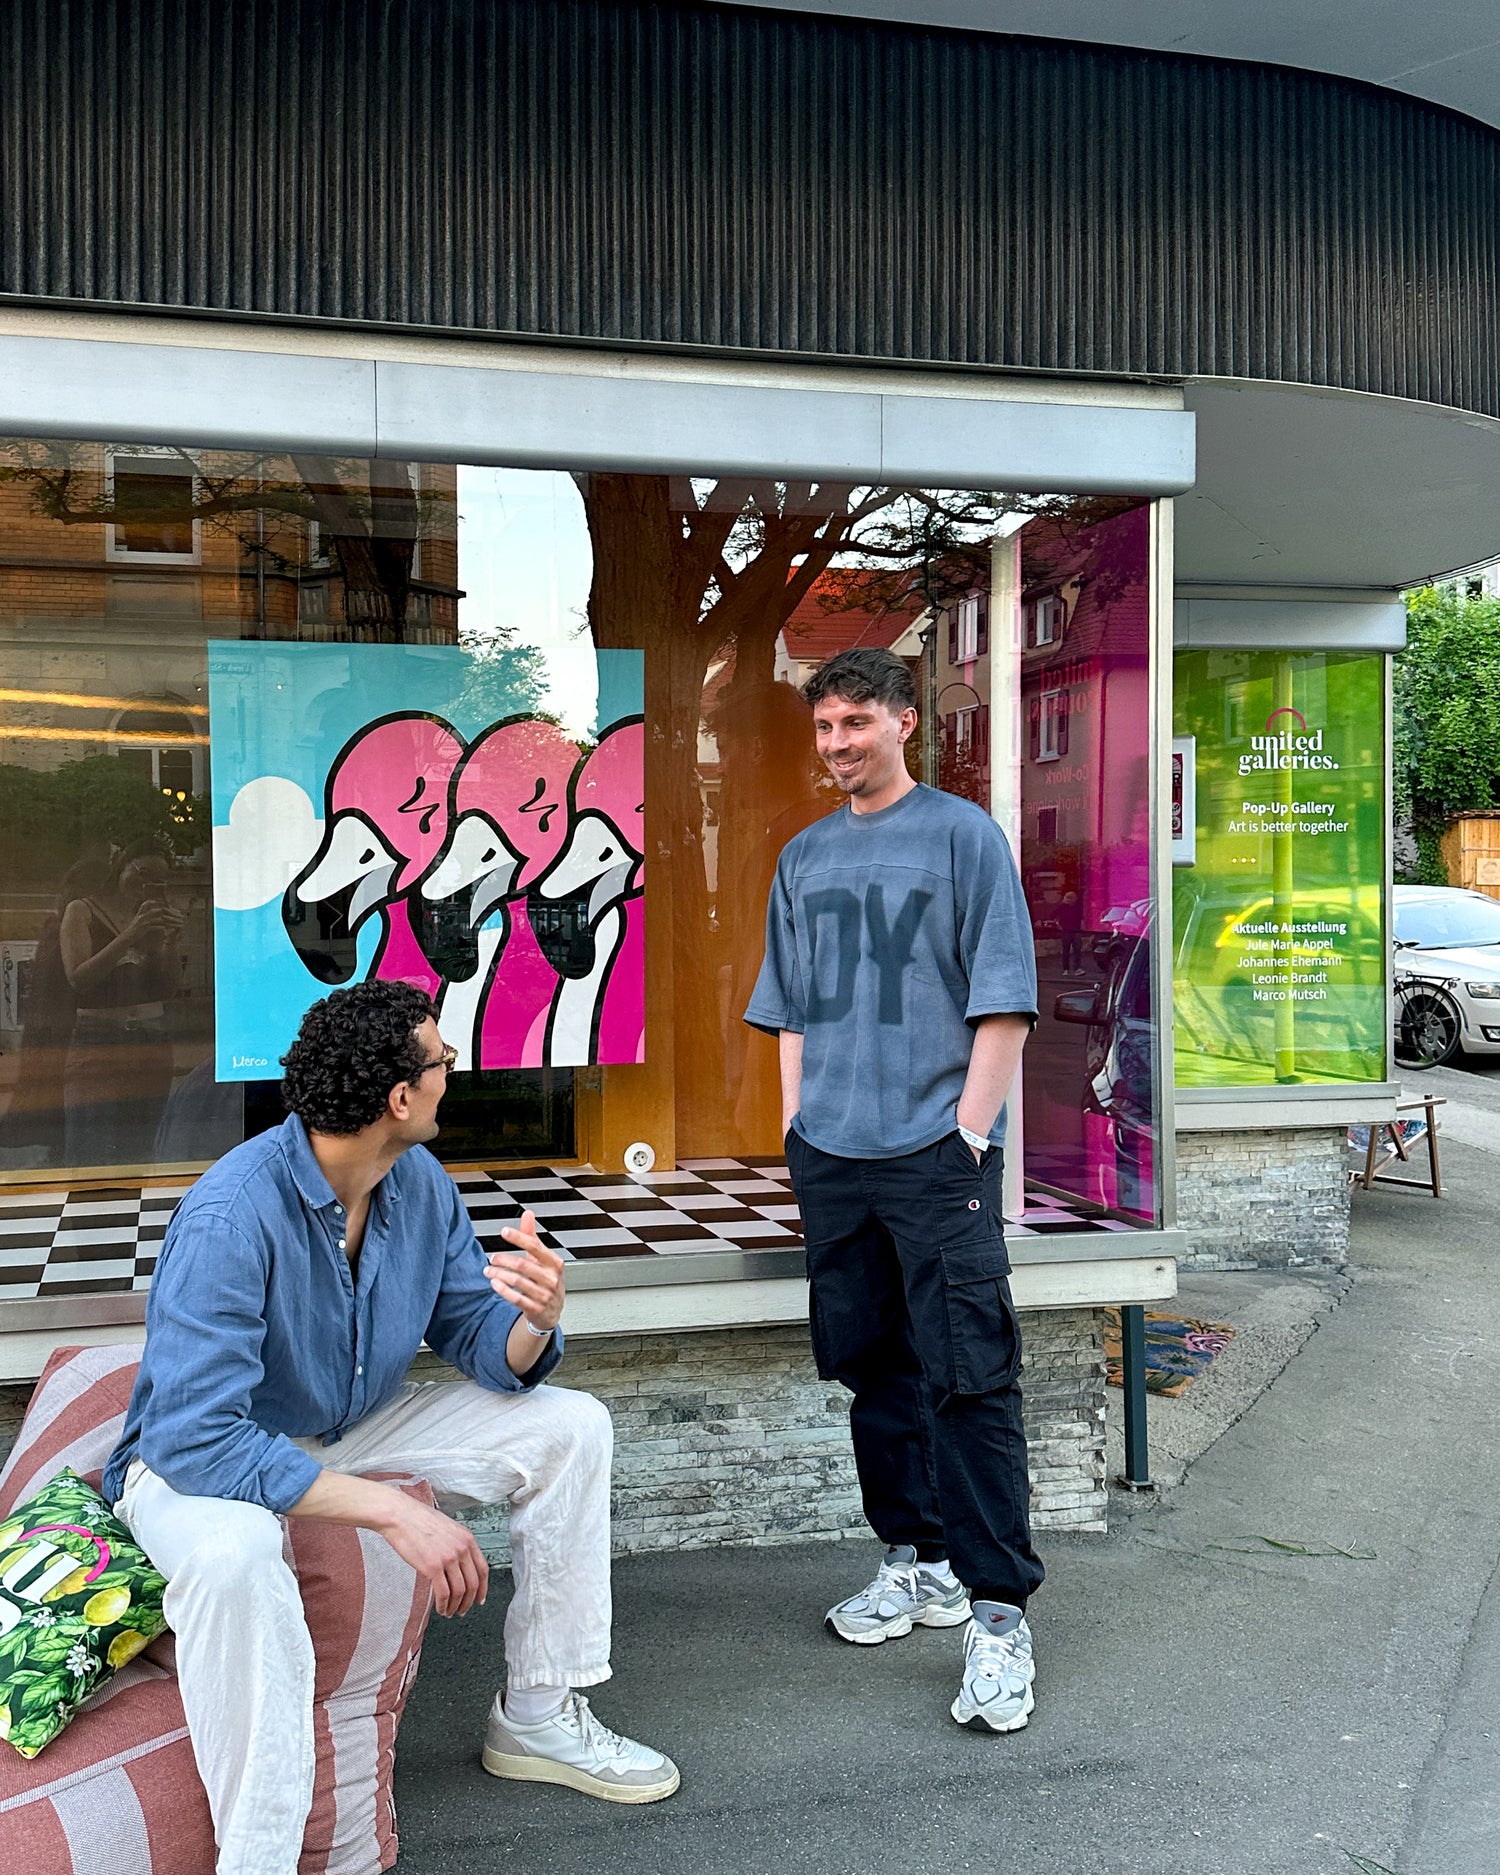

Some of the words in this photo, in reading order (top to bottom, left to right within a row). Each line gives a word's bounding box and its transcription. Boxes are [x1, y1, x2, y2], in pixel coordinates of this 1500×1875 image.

[1250, 729, 1323, 751] united
[1238, 749, 1340, 776] galleries.
[1242, 801, 1288, 817] Pop-Up
[1290, 801, 1335, 817] Gallery
[1228, 820, 1247, 833] Art
[1249, 820, 1259, 833] is
[1261, 819, 1297, 833] better
[1299, 819, 1349, 836] together
[1232, 921, 1279, 934] Aktuelle
[1280, 921, 1347, 935] Ausstellung
[1245, 939, 1269, 951] Jule
[1270, 939, 1300, 951] Marie
[1302, 937, 1334, 952] Appel
[1237, 956, 1290, 968] Johannes
[1291, 955, 1342, 967] Ehemann
[1252, 972, 1289, 985] Leonie
[1290, 971, 1328, 984] Brandt
[1252, 988, 1286, 1001] Marco
[1288, 987, 1327, 1000] Mutsch
